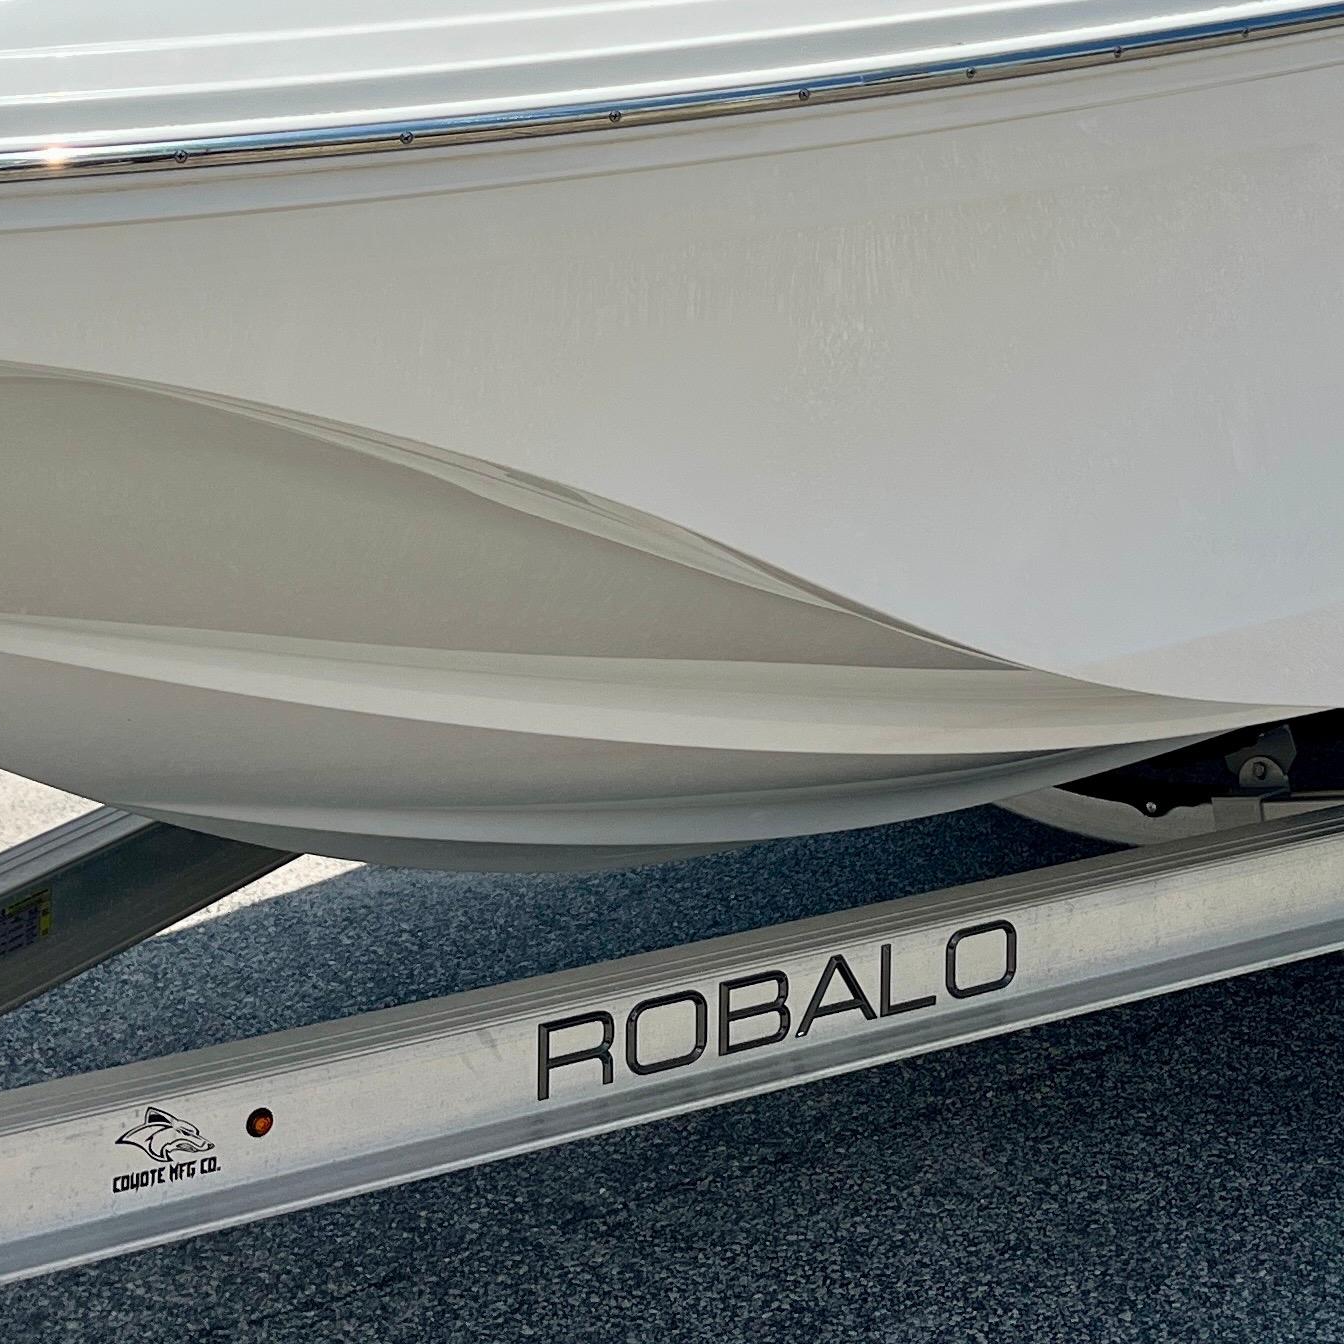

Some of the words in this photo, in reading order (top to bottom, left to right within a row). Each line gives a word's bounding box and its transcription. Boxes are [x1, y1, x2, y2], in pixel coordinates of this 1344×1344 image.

[537, 919, 1017, 1102] ROBALO
[112, 1166, 167, 1193] COYOTE
[169, 1159, 198, 1183] MFG
[200, 1156, 222, 1175] CO.
